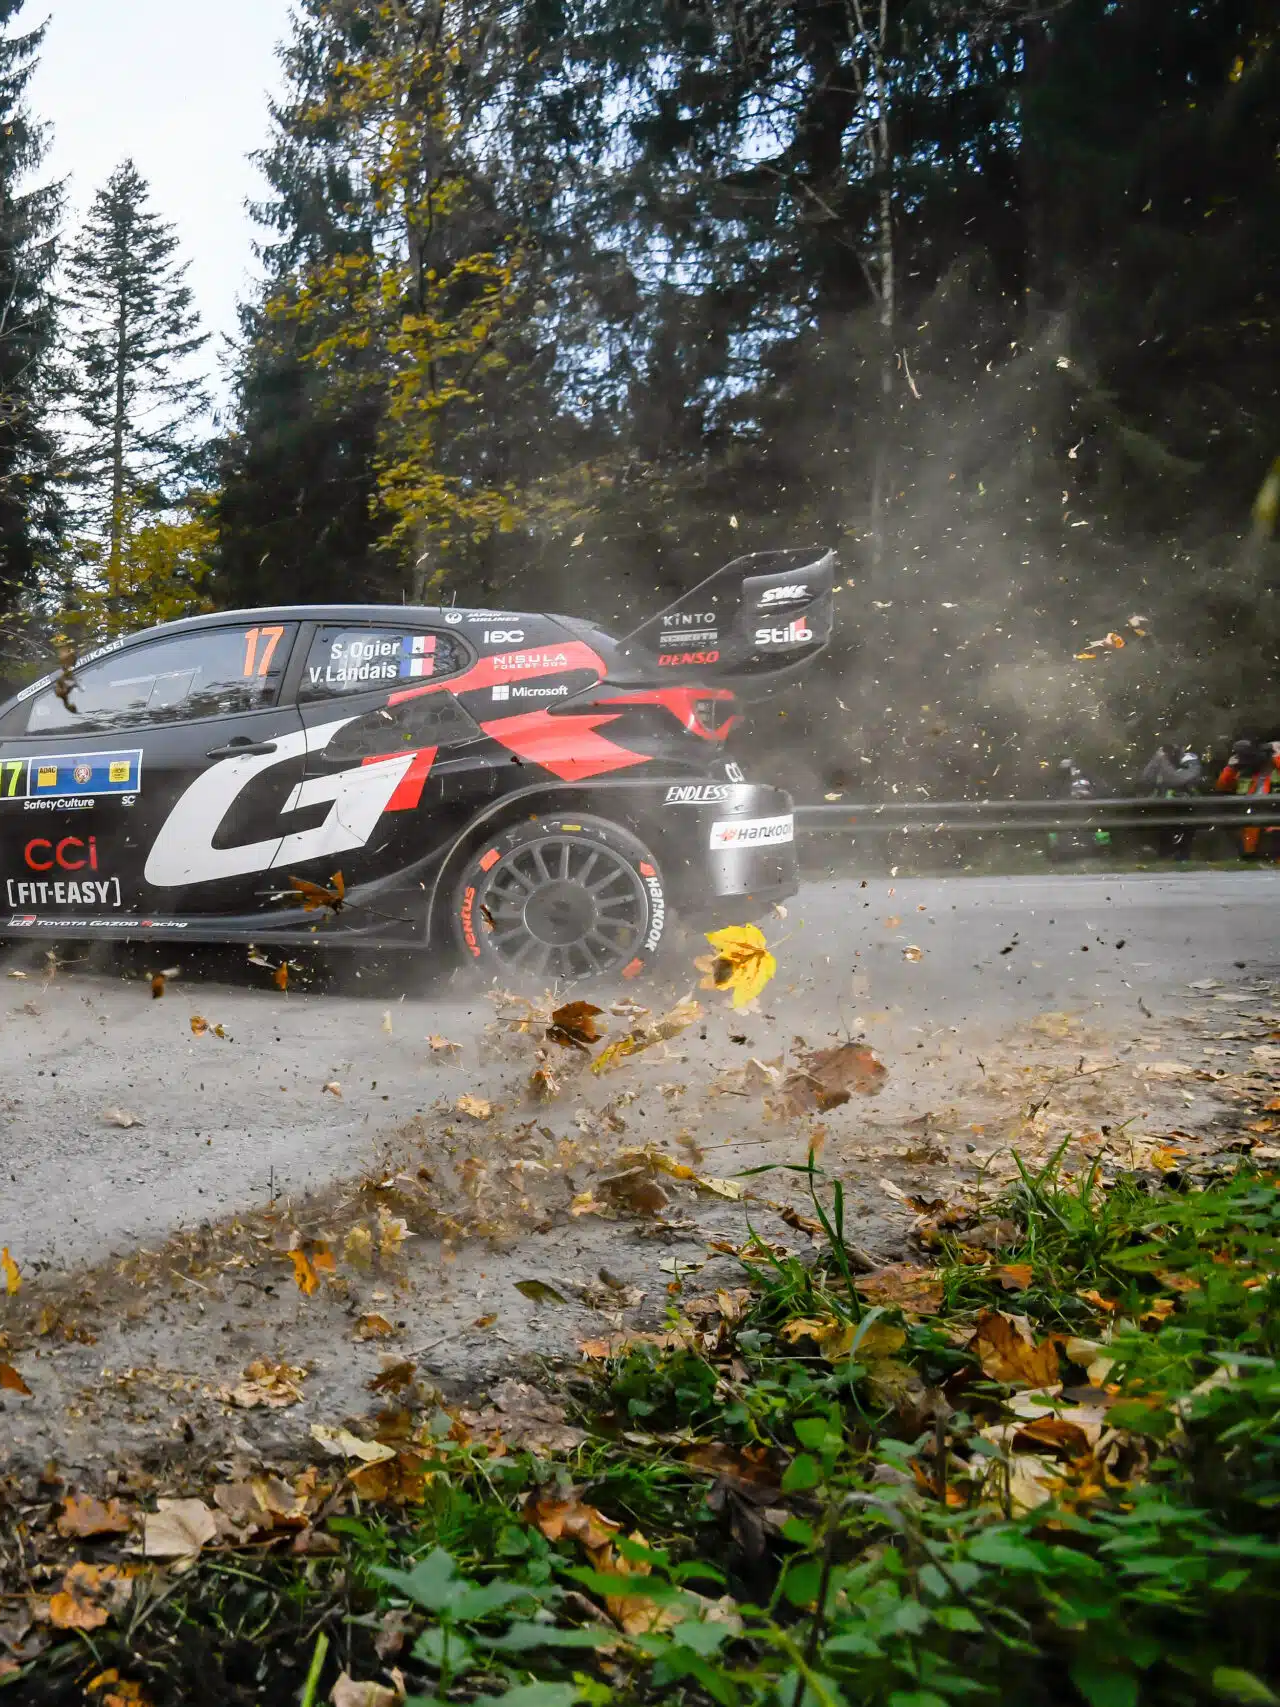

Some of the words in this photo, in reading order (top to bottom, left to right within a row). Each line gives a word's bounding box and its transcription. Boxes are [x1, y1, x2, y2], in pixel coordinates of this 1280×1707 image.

[754, 618, 813, 645] Stilo
[243, 626, 285, 677] 17
[493, 653, 567, 665] NISULA
[657, 650, 720, 667] DENSO
[512, 685, 568, 697] Microsoft
[39, 766, 56, 774] ADAC
[121, 795, 136, 804] SC
[665, 785, 730, 801] ENDLESS
[23, 798, 95, 811] SafetyCulture
